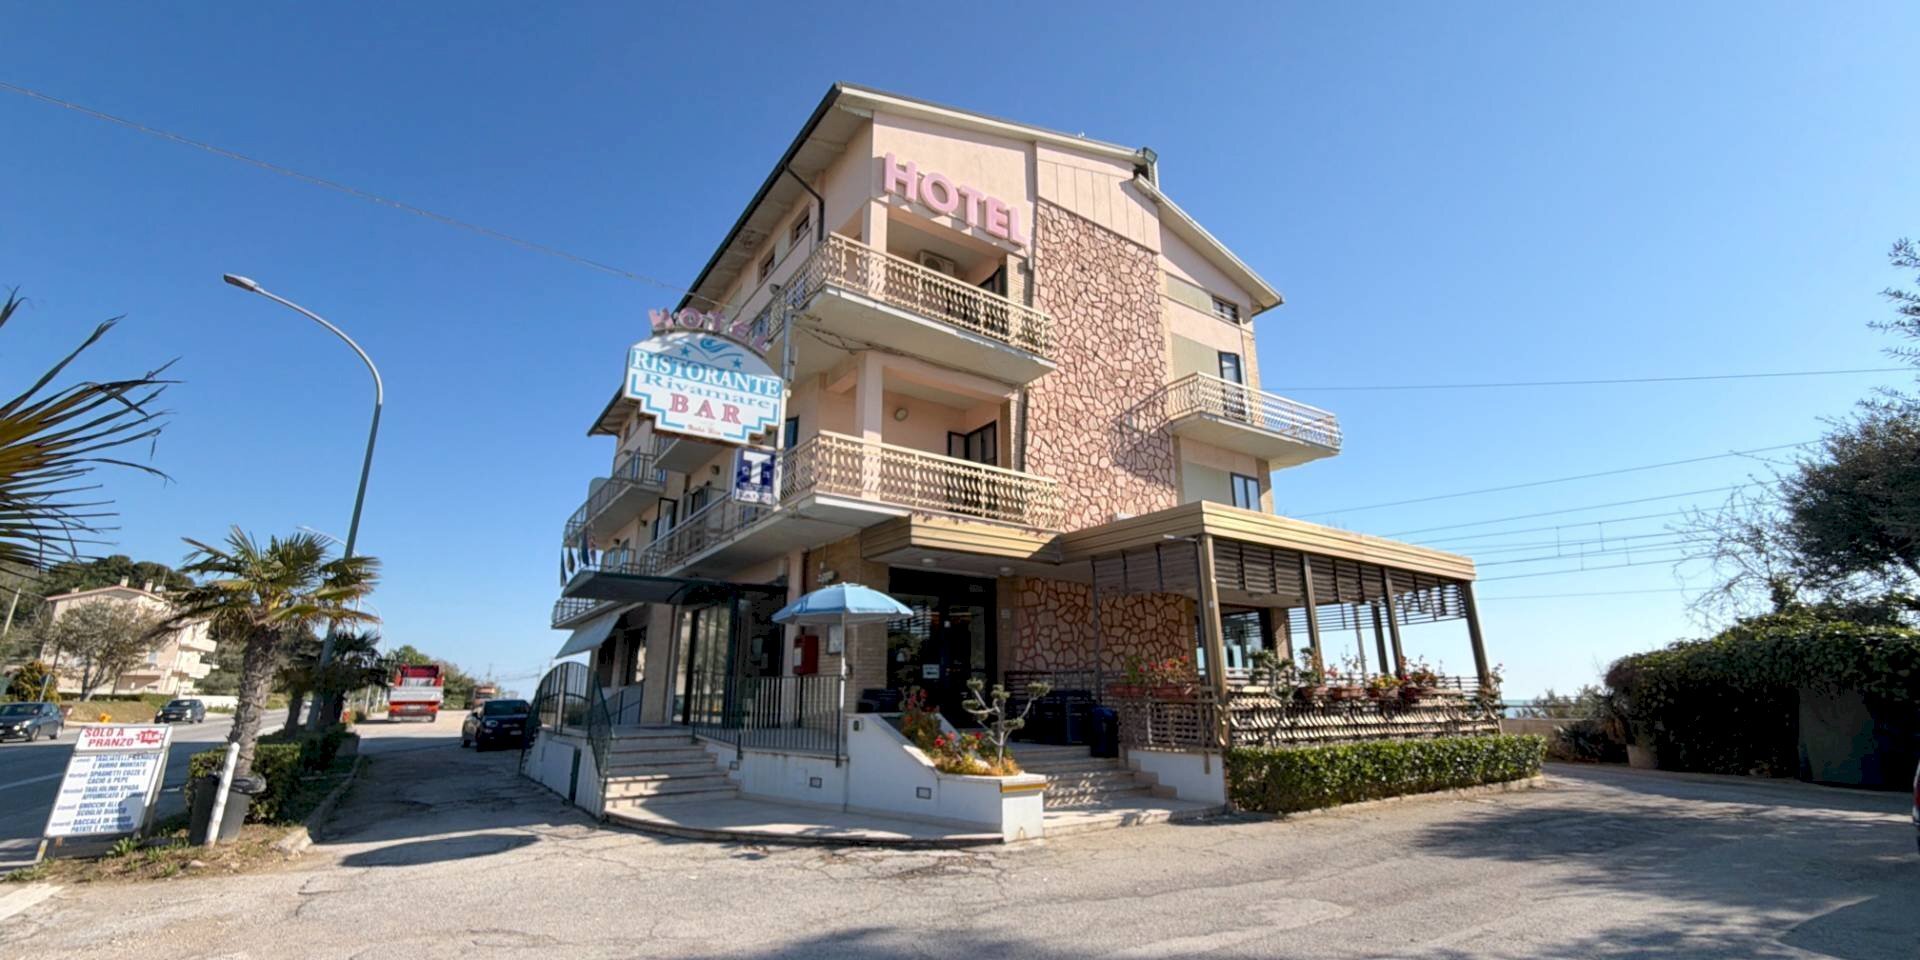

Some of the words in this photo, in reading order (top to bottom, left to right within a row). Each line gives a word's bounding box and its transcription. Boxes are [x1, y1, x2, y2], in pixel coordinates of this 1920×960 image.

[884, 152, 1030, 247] HOTEL
[648, 307, 770, 353] HOTEL
[632, 350, 780, 397] RISTORANTE
[643, 374, 771, 409] Rivamare
[669, 393, 742, 425] BAR
[84, 727, 114, 738] SOLO
[117, 728, 125, 737] A
[88, 738, 134, 747] PRANZO
